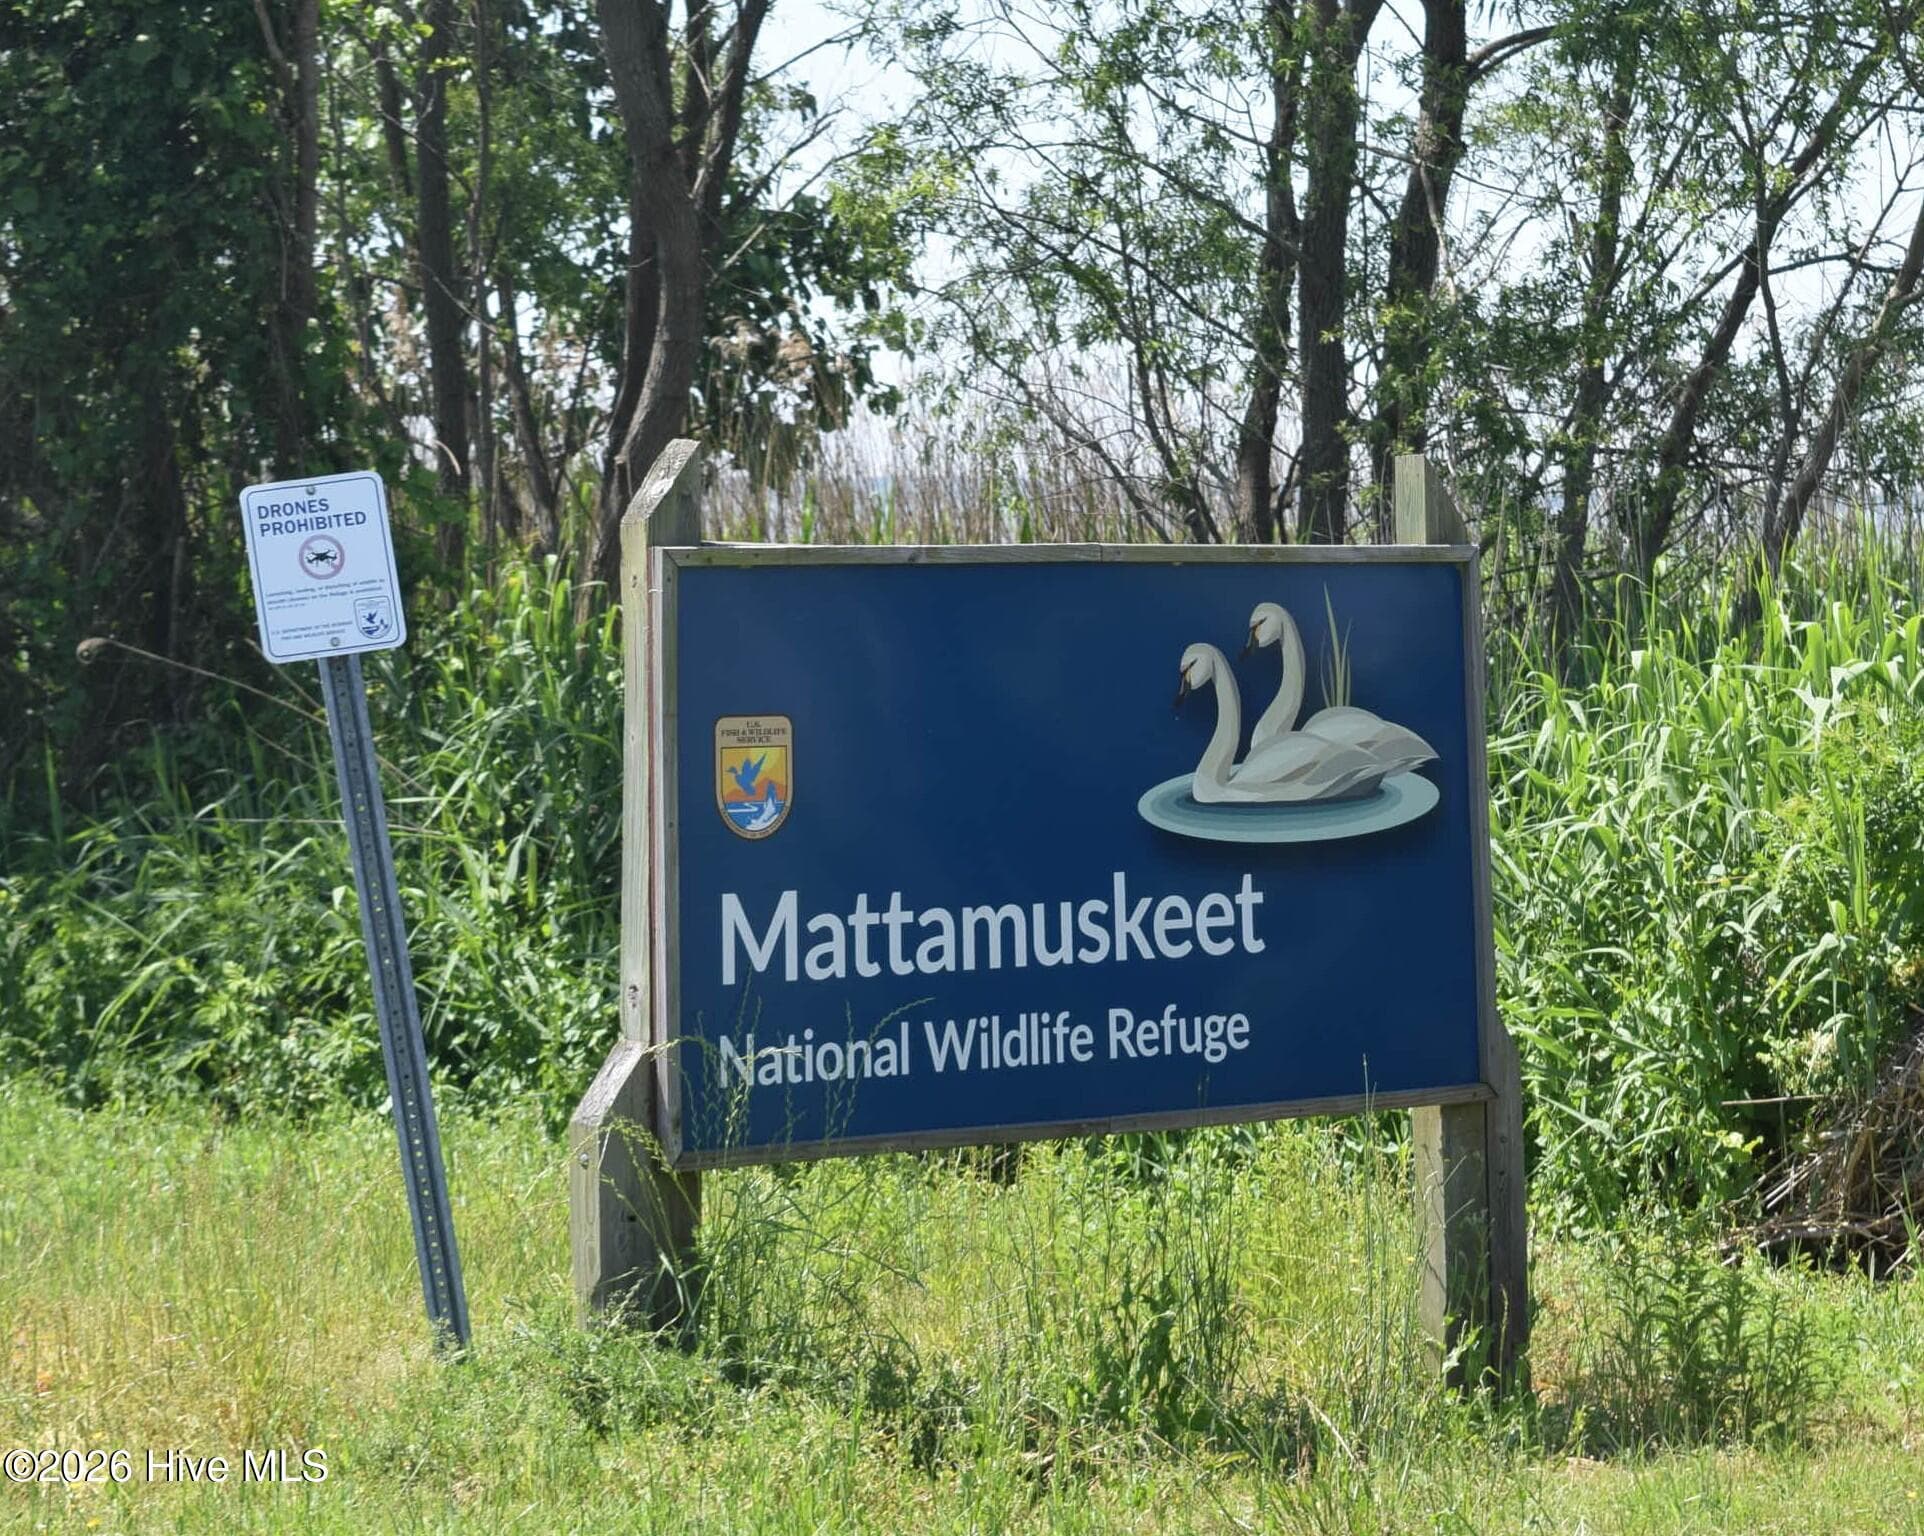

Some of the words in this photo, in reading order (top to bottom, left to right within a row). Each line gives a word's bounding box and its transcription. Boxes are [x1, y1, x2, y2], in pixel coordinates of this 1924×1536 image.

[257, 498, 330, 520] DRONES
[259, 511, 367, 537] PROHIBITED
[736, 736, 771, 744] SERVICE
[720, 871, 1266, 986] Mattamuskeet
[718, 1021, 910, 1089] National
[924, 1010, 1095, 1073] Wildlife
[1108, 1003, 1251, 1064] Refuge
